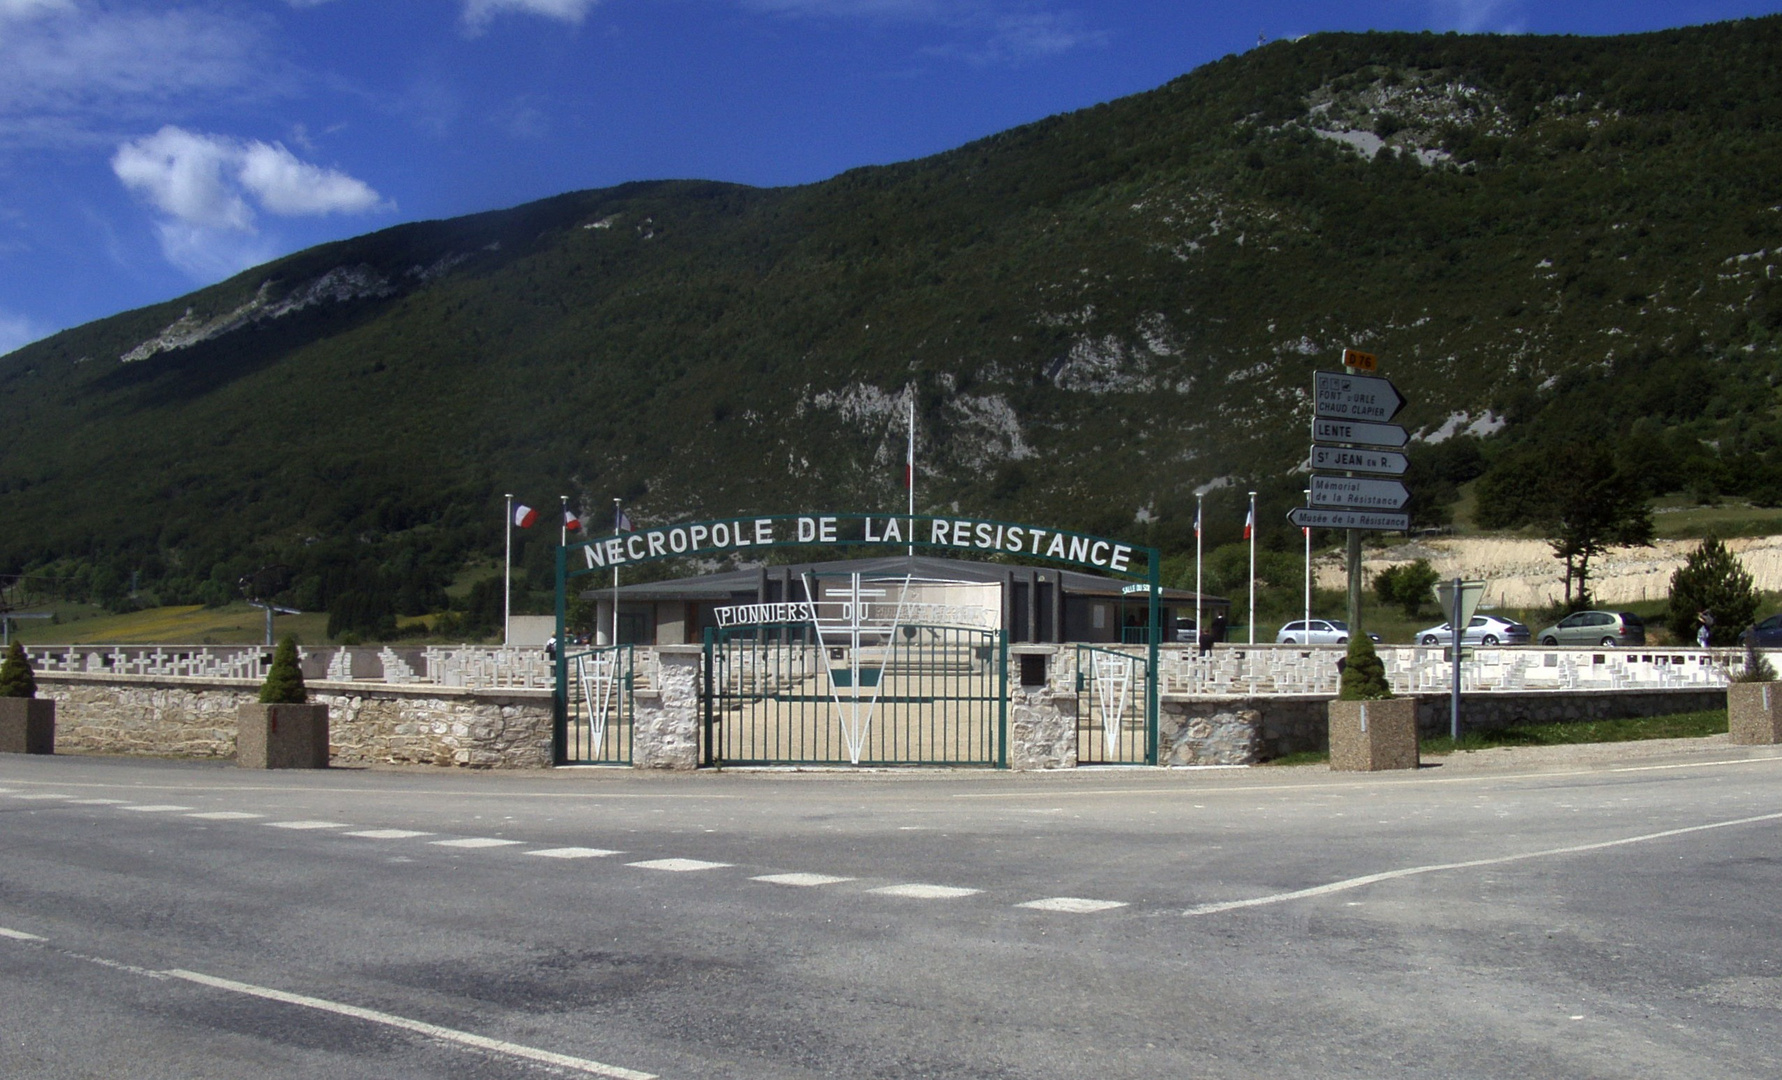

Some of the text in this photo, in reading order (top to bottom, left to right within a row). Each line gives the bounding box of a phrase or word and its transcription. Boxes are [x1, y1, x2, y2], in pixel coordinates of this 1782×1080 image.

[1350, 354, 1372, 368] D 76
[1319, 391, 1342, 400] FONT
[1319, 402, 1385, 417] CHAUD CLAPIER
[1318, 424, 1352, 438] LENTE
[1334, 454, 1362, 466] JEAN
[1381, 457, 1392, 468] R.
[1316, 480, 1360, 492] Mémorial
[1316, 492, 1398, 506] de la Résistance
[1299, 514, 1405, 526] Musée de la Résistance
[584, 517, 1132, 572] NECROPOLE DE LA RESISTANCE
[721, 604, 810, 625] PIONNIERS
[843, 603, 869, 620] DU
[906, 602, 988, 626] VERS
